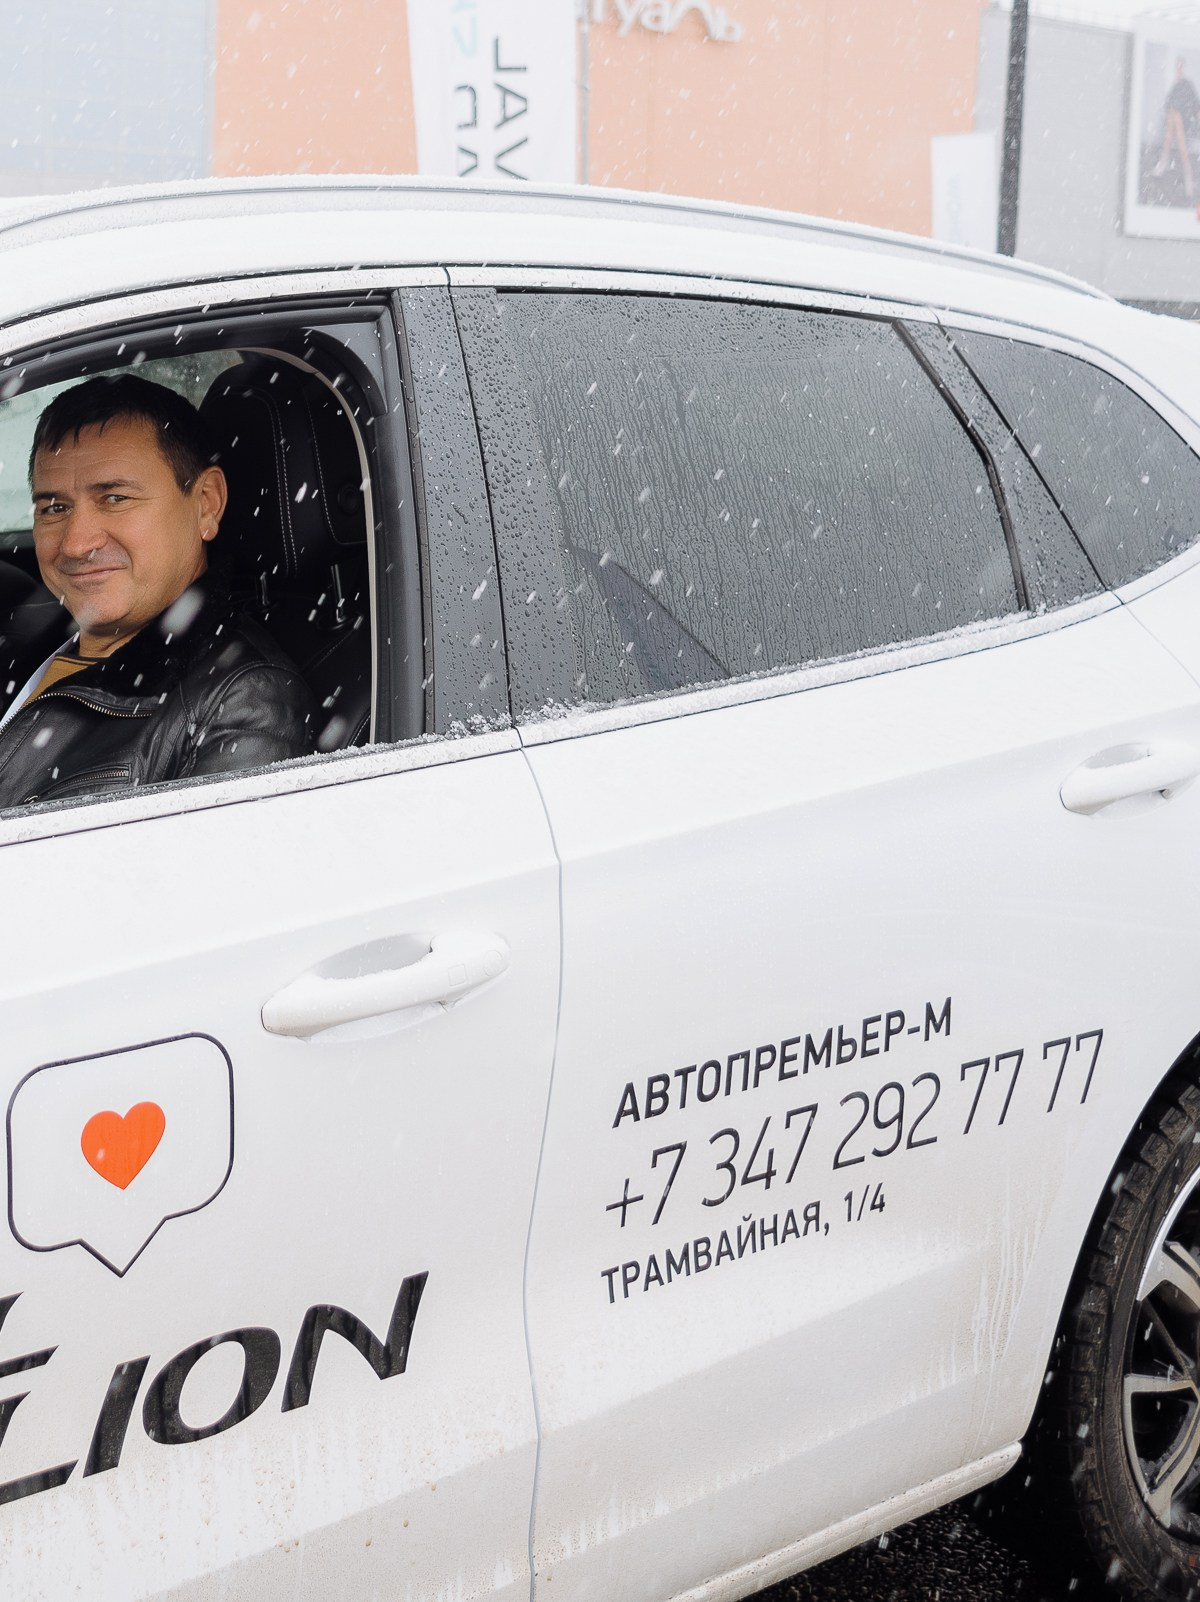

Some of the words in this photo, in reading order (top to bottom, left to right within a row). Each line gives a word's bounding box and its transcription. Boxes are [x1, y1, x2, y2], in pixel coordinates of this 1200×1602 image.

[604, 1140, 688, 1228] +7
[701, 1102, 819, 1209] 347
[832, 1071, 942, 1171] 292
[959, 1047, 1025, 1136] 77
[1042, 1028, 1104, 1114] 77
[611, 995, 953, 1129] АВТОПРЕМЬЕР-М
[600, 1199, 831, 1304] ТРАМВАЙНАЯ,
[842, 1181, 887, 1223] 1/4
